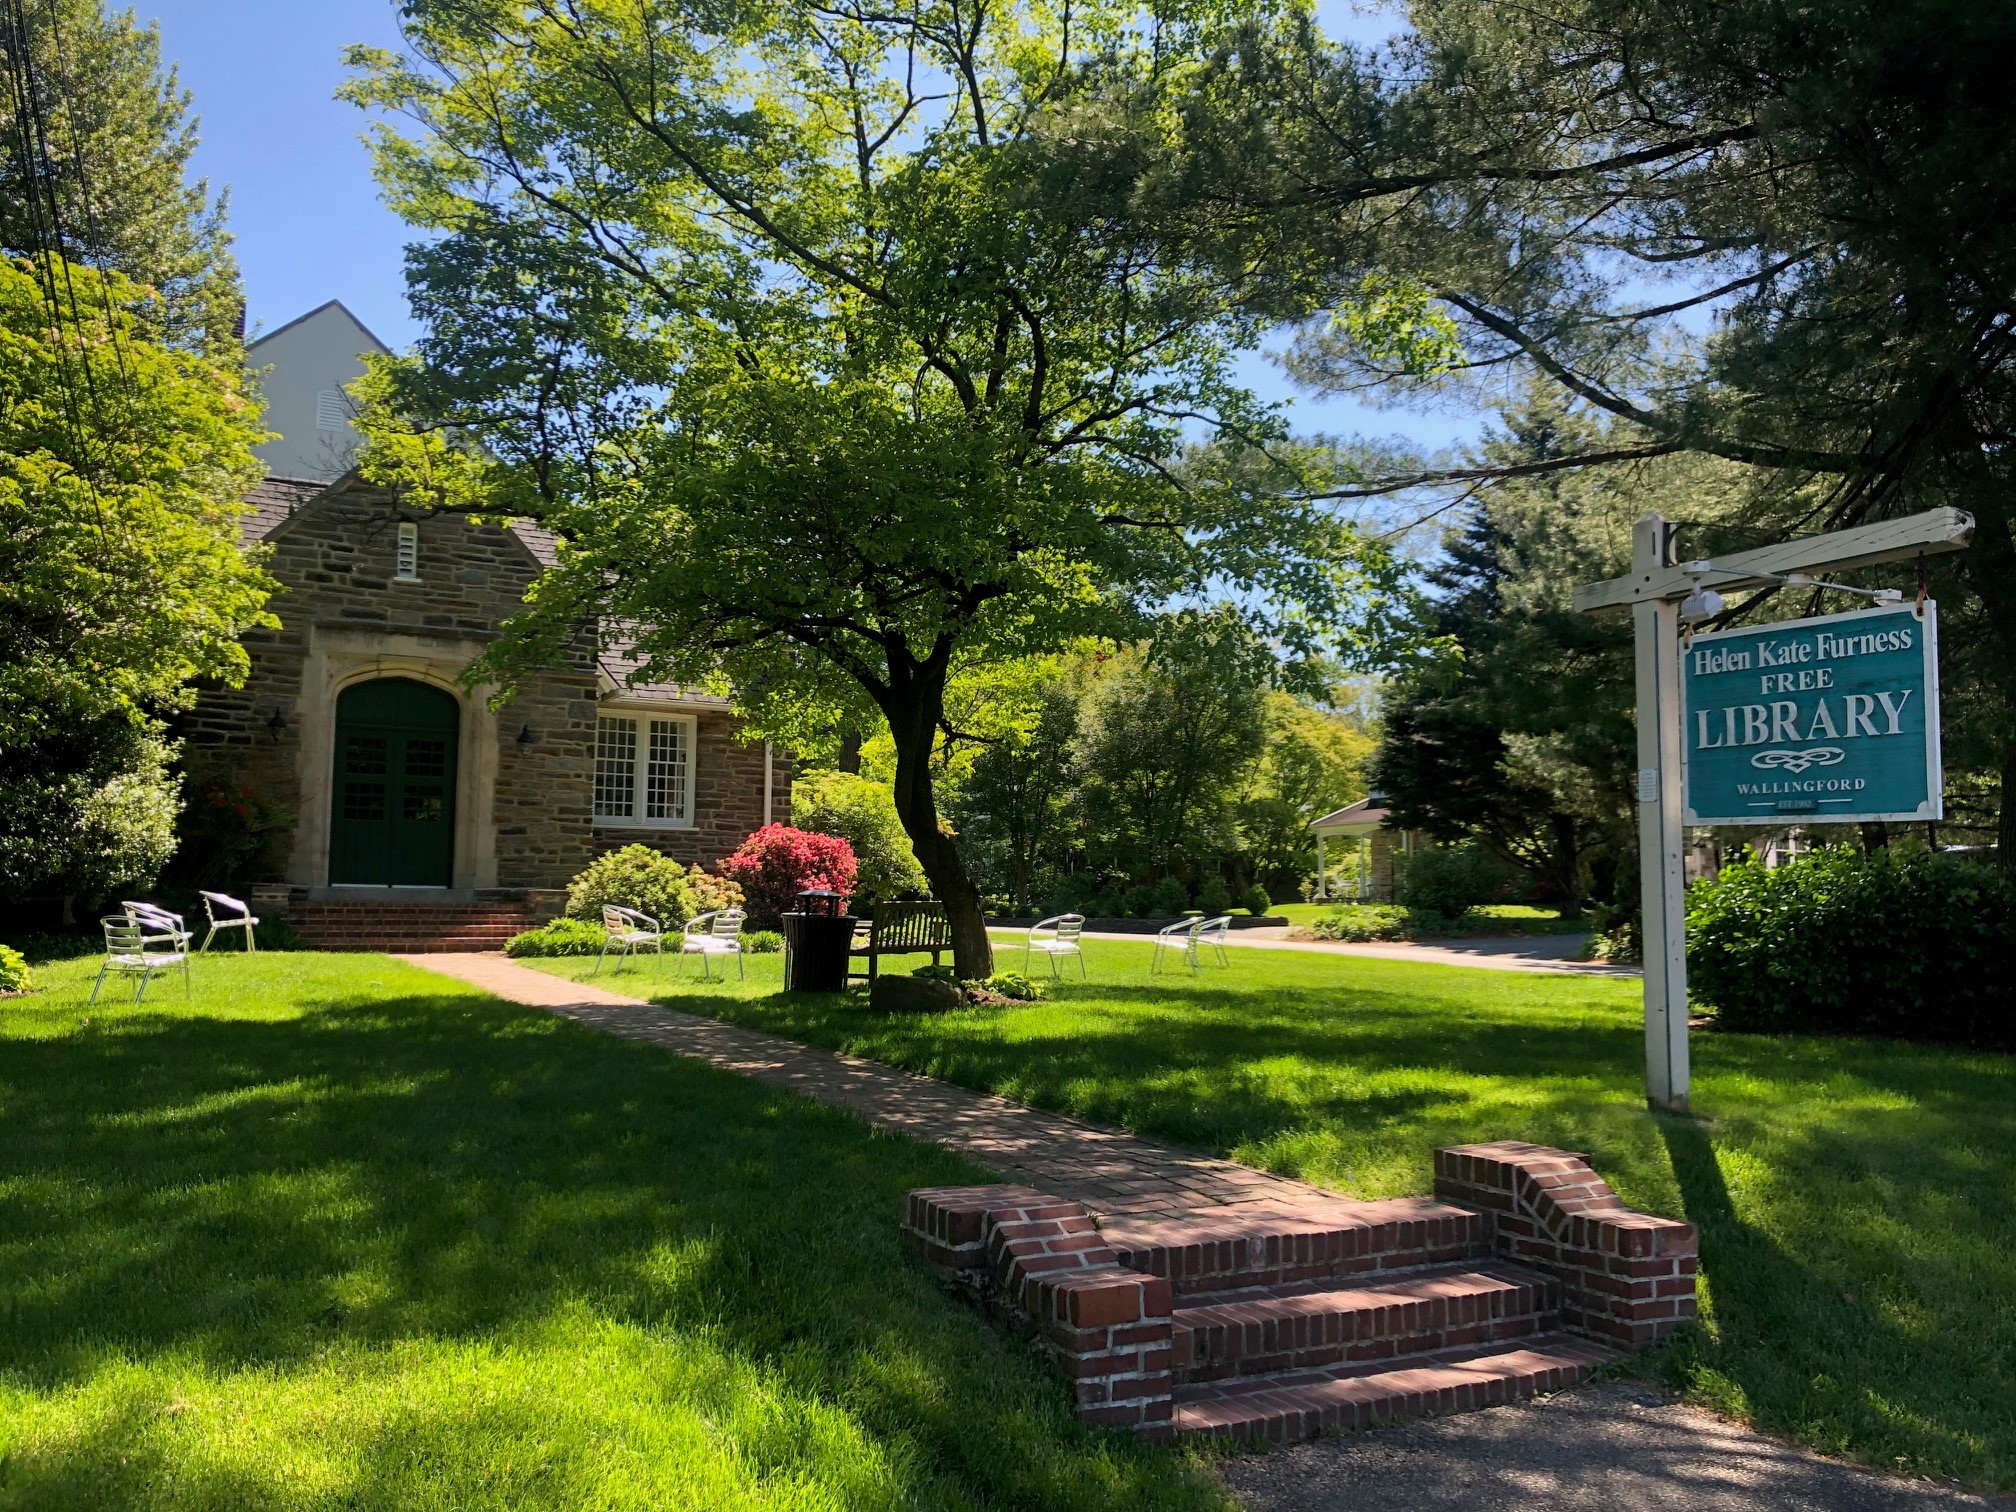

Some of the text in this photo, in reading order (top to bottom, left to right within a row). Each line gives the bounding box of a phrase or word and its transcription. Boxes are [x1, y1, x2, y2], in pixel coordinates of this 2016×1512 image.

[1694, 628, 1912, 675] Helen Kate Furness
[1760, 668, 1834, 695] FREE
[1695, 690, 1912, 749] LIBRARY
[1737, 778, 1866, 795] WALLINGFORD
